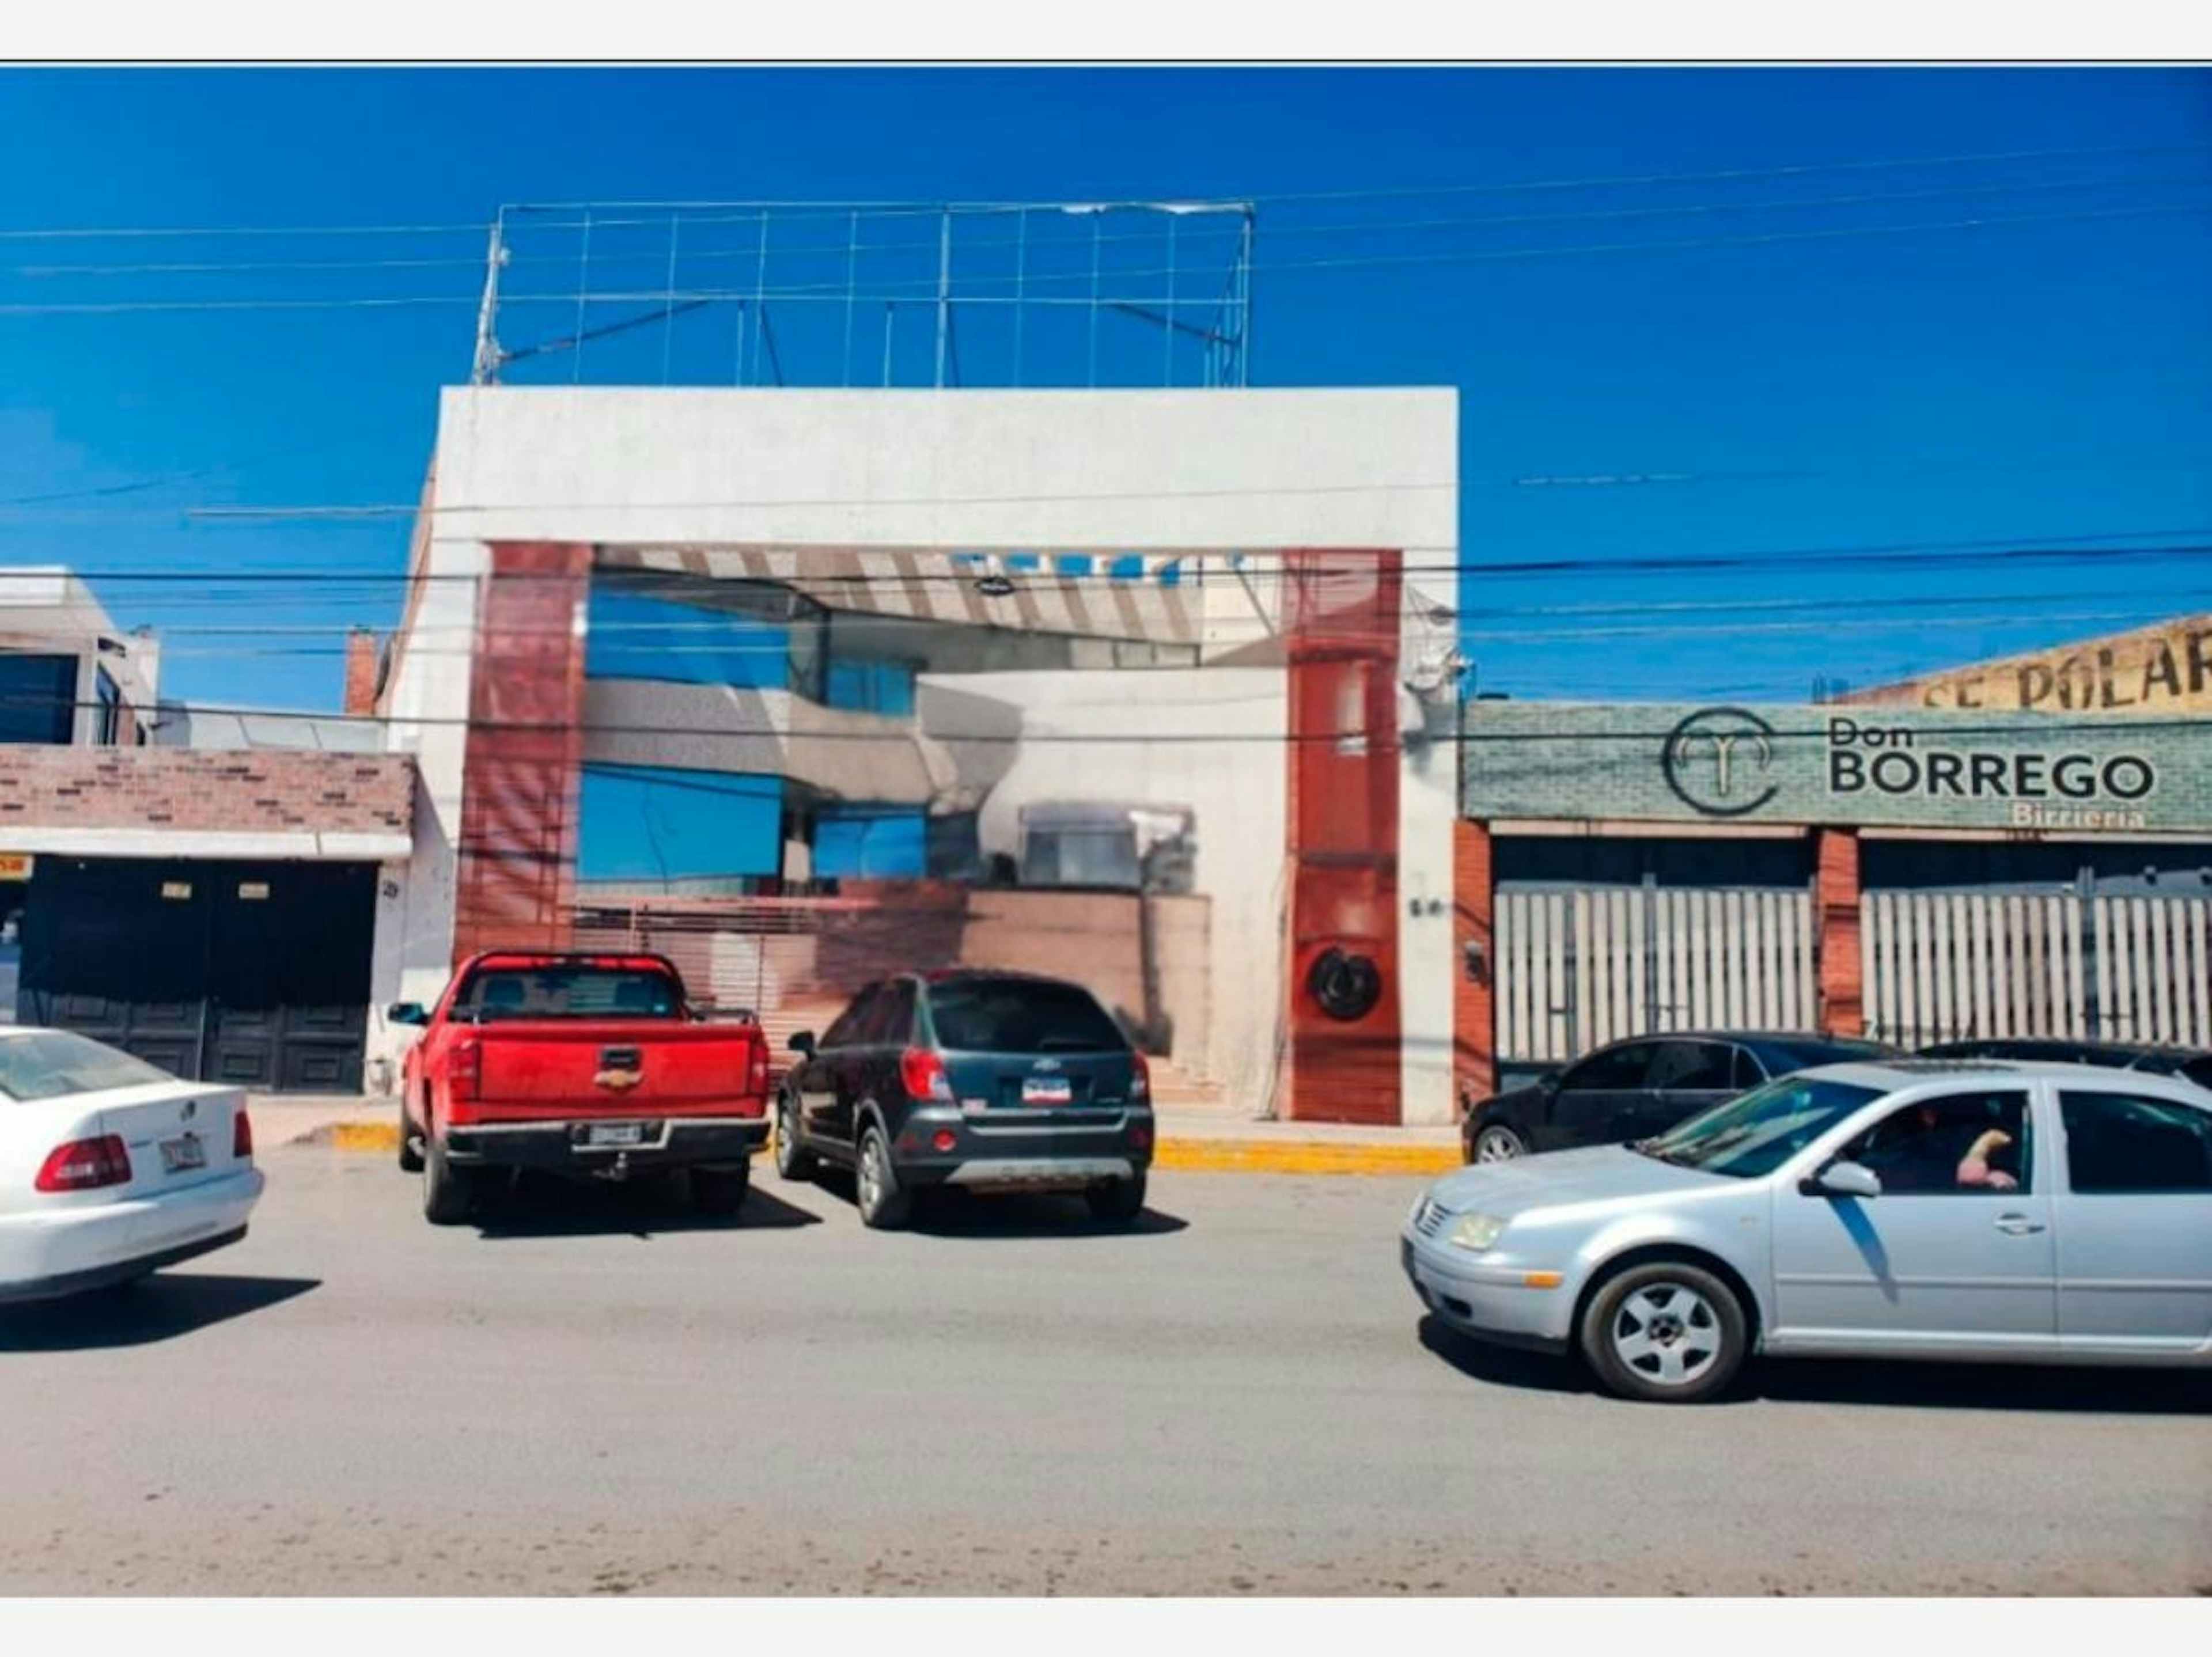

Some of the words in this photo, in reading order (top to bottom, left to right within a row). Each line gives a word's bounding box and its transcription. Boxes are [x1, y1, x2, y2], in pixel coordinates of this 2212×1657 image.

[1830, 718, 1914, 748] Don
[1830, 751, 2154, 799] BORREGO
[2013, 801, 2145, 828] Birrieria
